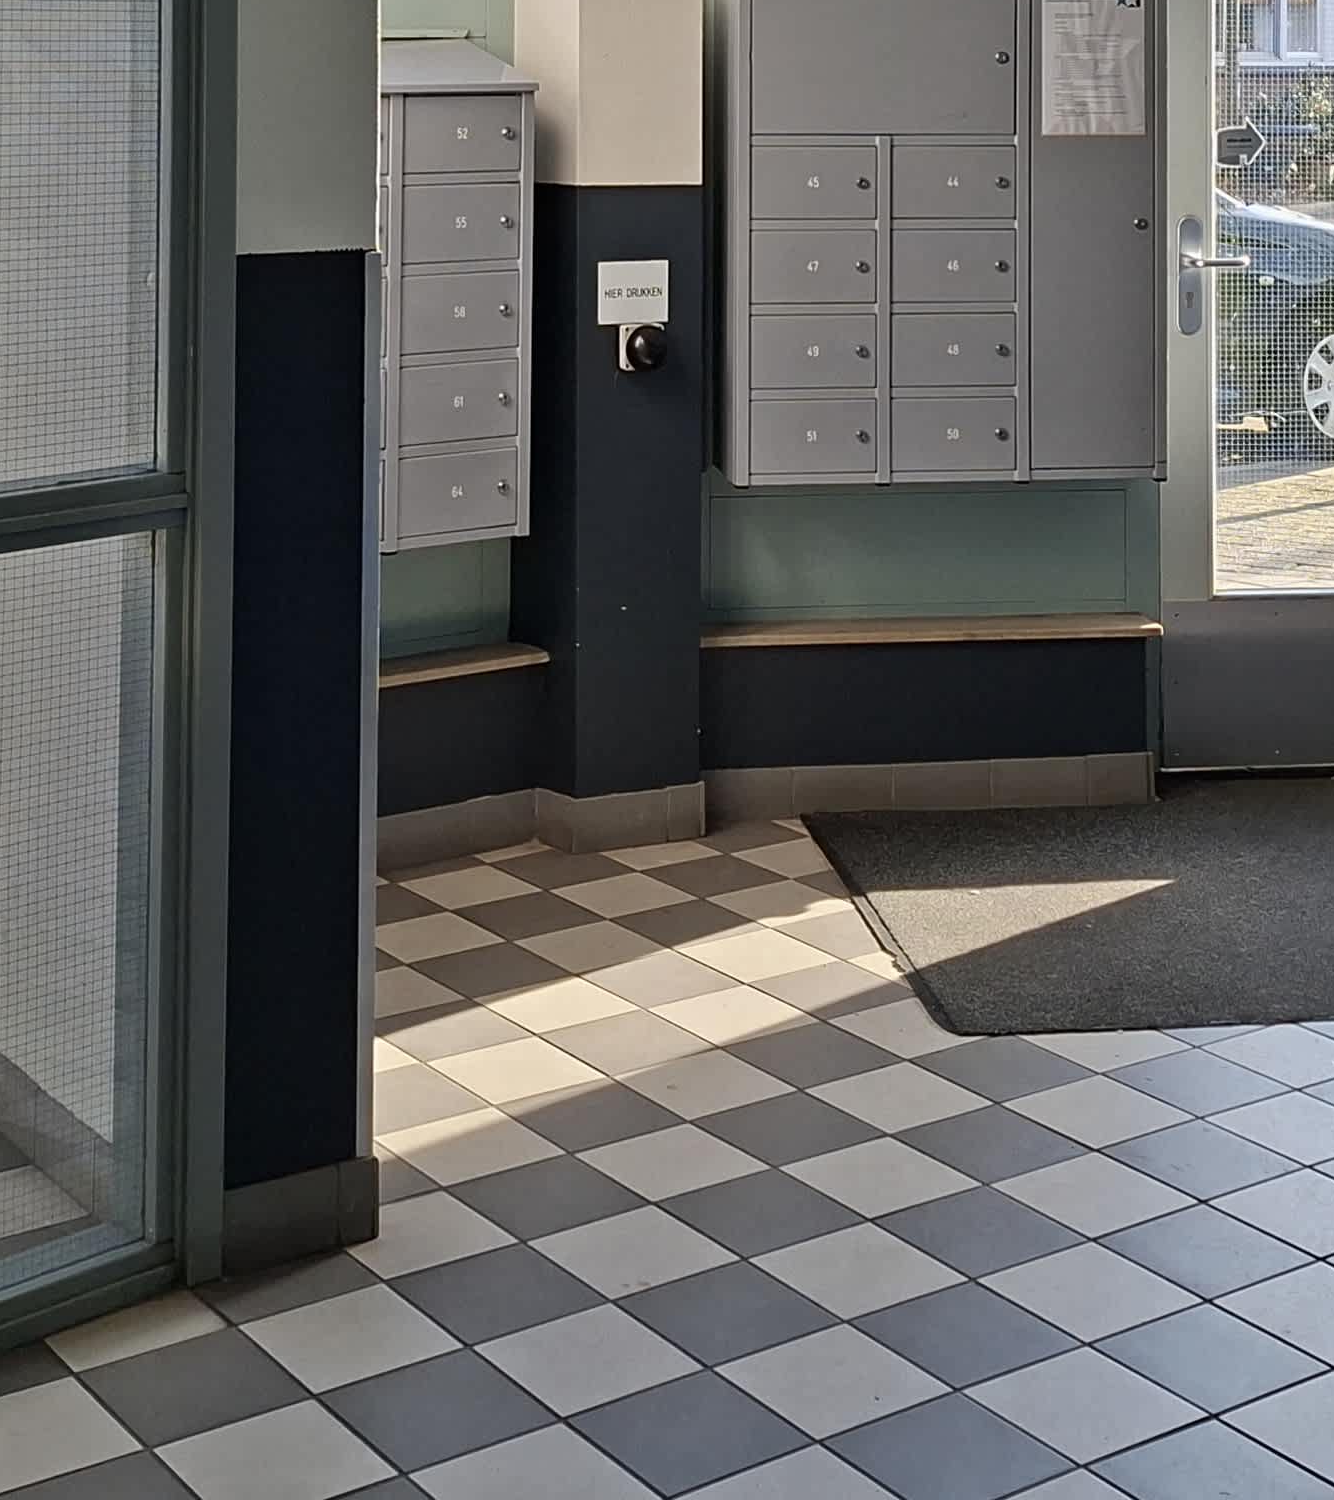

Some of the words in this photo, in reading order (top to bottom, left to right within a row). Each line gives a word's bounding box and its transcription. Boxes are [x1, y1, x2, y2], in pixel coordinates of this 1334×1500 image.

[457, 127, 468, 140] 52
[807, 176, 820, 188] 45
[947, 176, 959, 188] 44
[455, 216, 467, 229] 55
[807, 260, 819, 272] 47
[947, 259, 959, 271] 46
[605, 289, 623, 299] HIER
[626, 286, 663, 298] DRUKKEN
[454, 306, 466, 318] 58
[807, 345, 819, 357] 49
[947, 344, 959, 356] 48
[453, 395, 464, 408] 61
[807, 430, 817, 442] 51
[946, 428, 959, 440] 50
[451, 486, 463, 498] 64
